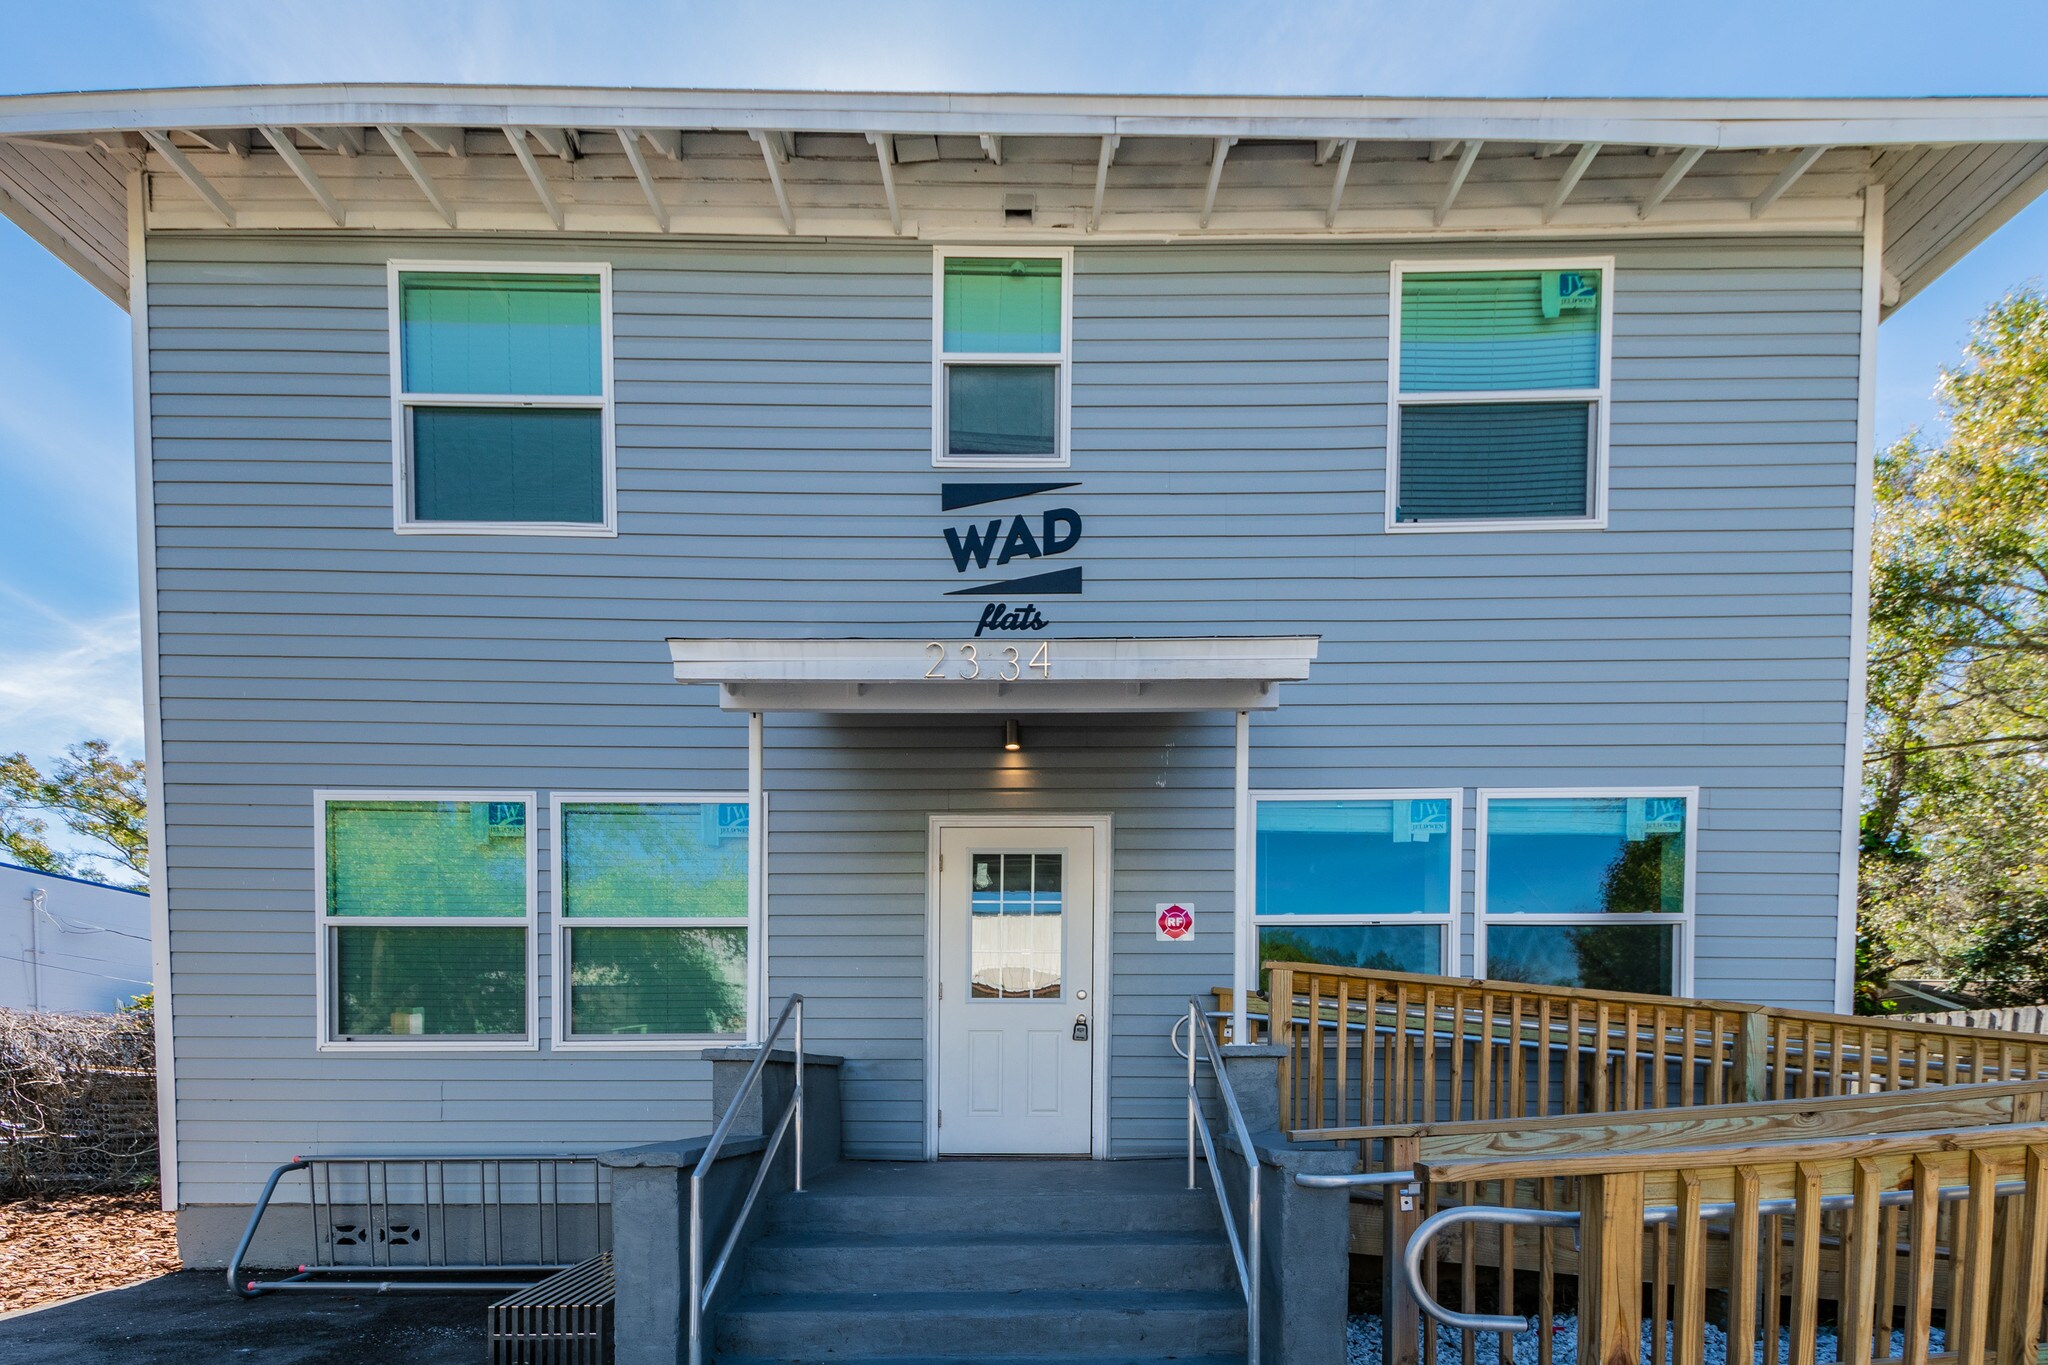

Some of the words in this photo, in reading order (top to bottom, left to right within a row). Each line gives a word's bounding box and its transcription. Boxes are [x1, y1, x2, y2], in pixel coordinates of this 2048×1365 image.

[943, 508, 1082, 573] WAD
[974, 603, 1050, 637] flats
[924, 641, 1051, 682] 2334
[491, 804, 520, 823] JW
[721, 805, 749, 824] JW
[1414, 801, 1442, 821] JW
[1647, 800, 1676, 819] JW
[1167, 917, 1183, 927] RF
